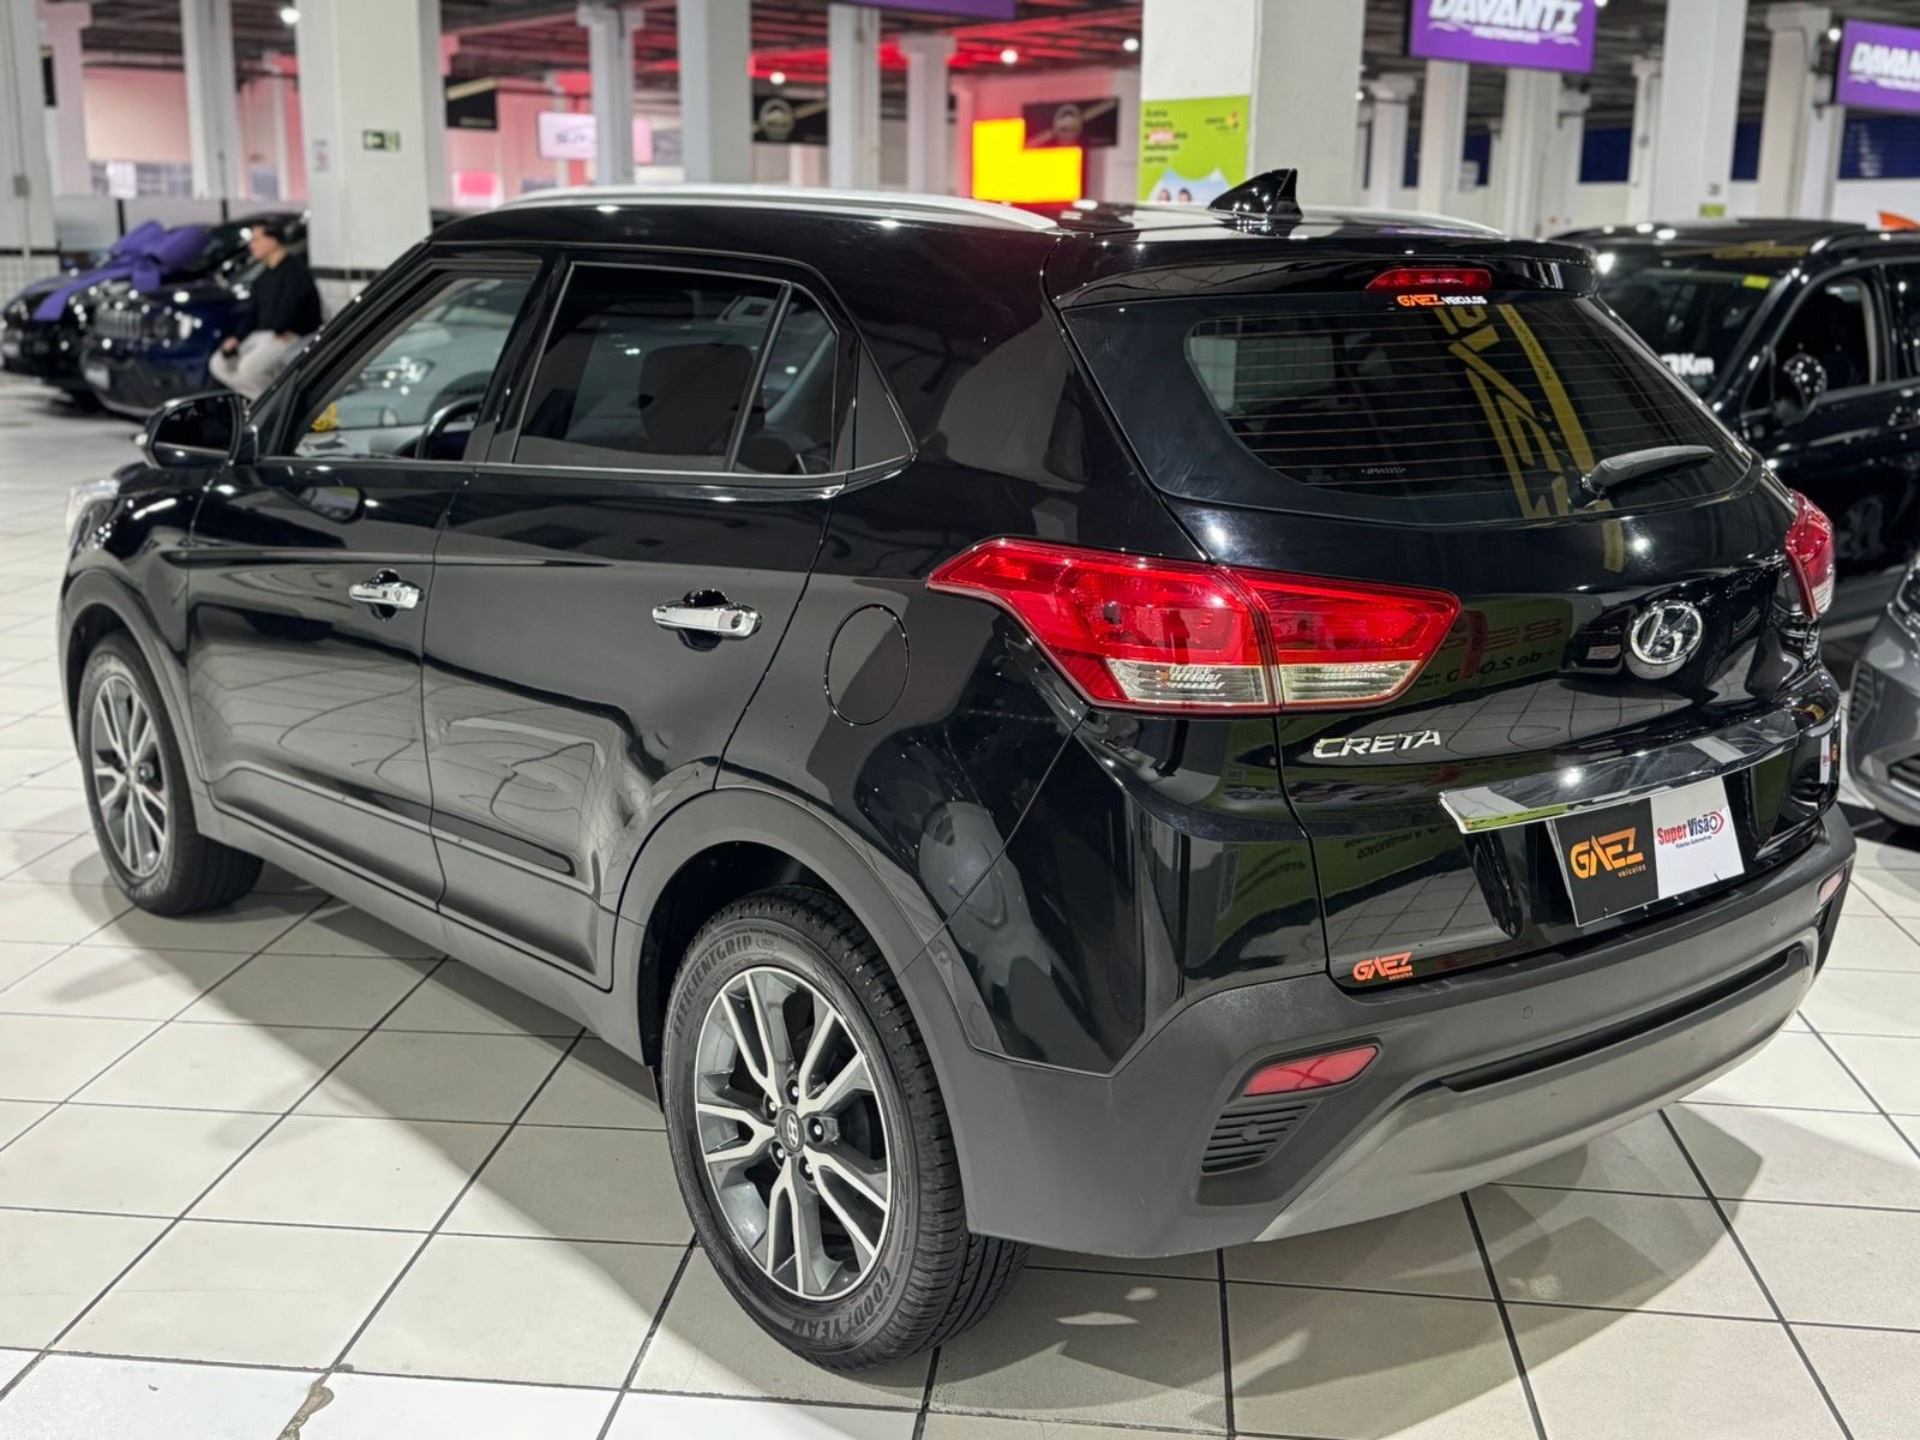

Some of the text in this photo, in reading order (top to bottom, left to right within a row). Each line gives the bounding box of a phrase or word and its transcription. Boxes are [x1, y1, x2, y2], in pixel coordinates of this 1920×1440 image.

[1313, 730, 1441, 758] CRETA
[1657, 824, 1687, 845] Super
[1687, 814, 1718, 836] Visão
[1570, 826, 1644, 879] GAEZ
[1353, 952, 1412, 980] GAEZ
